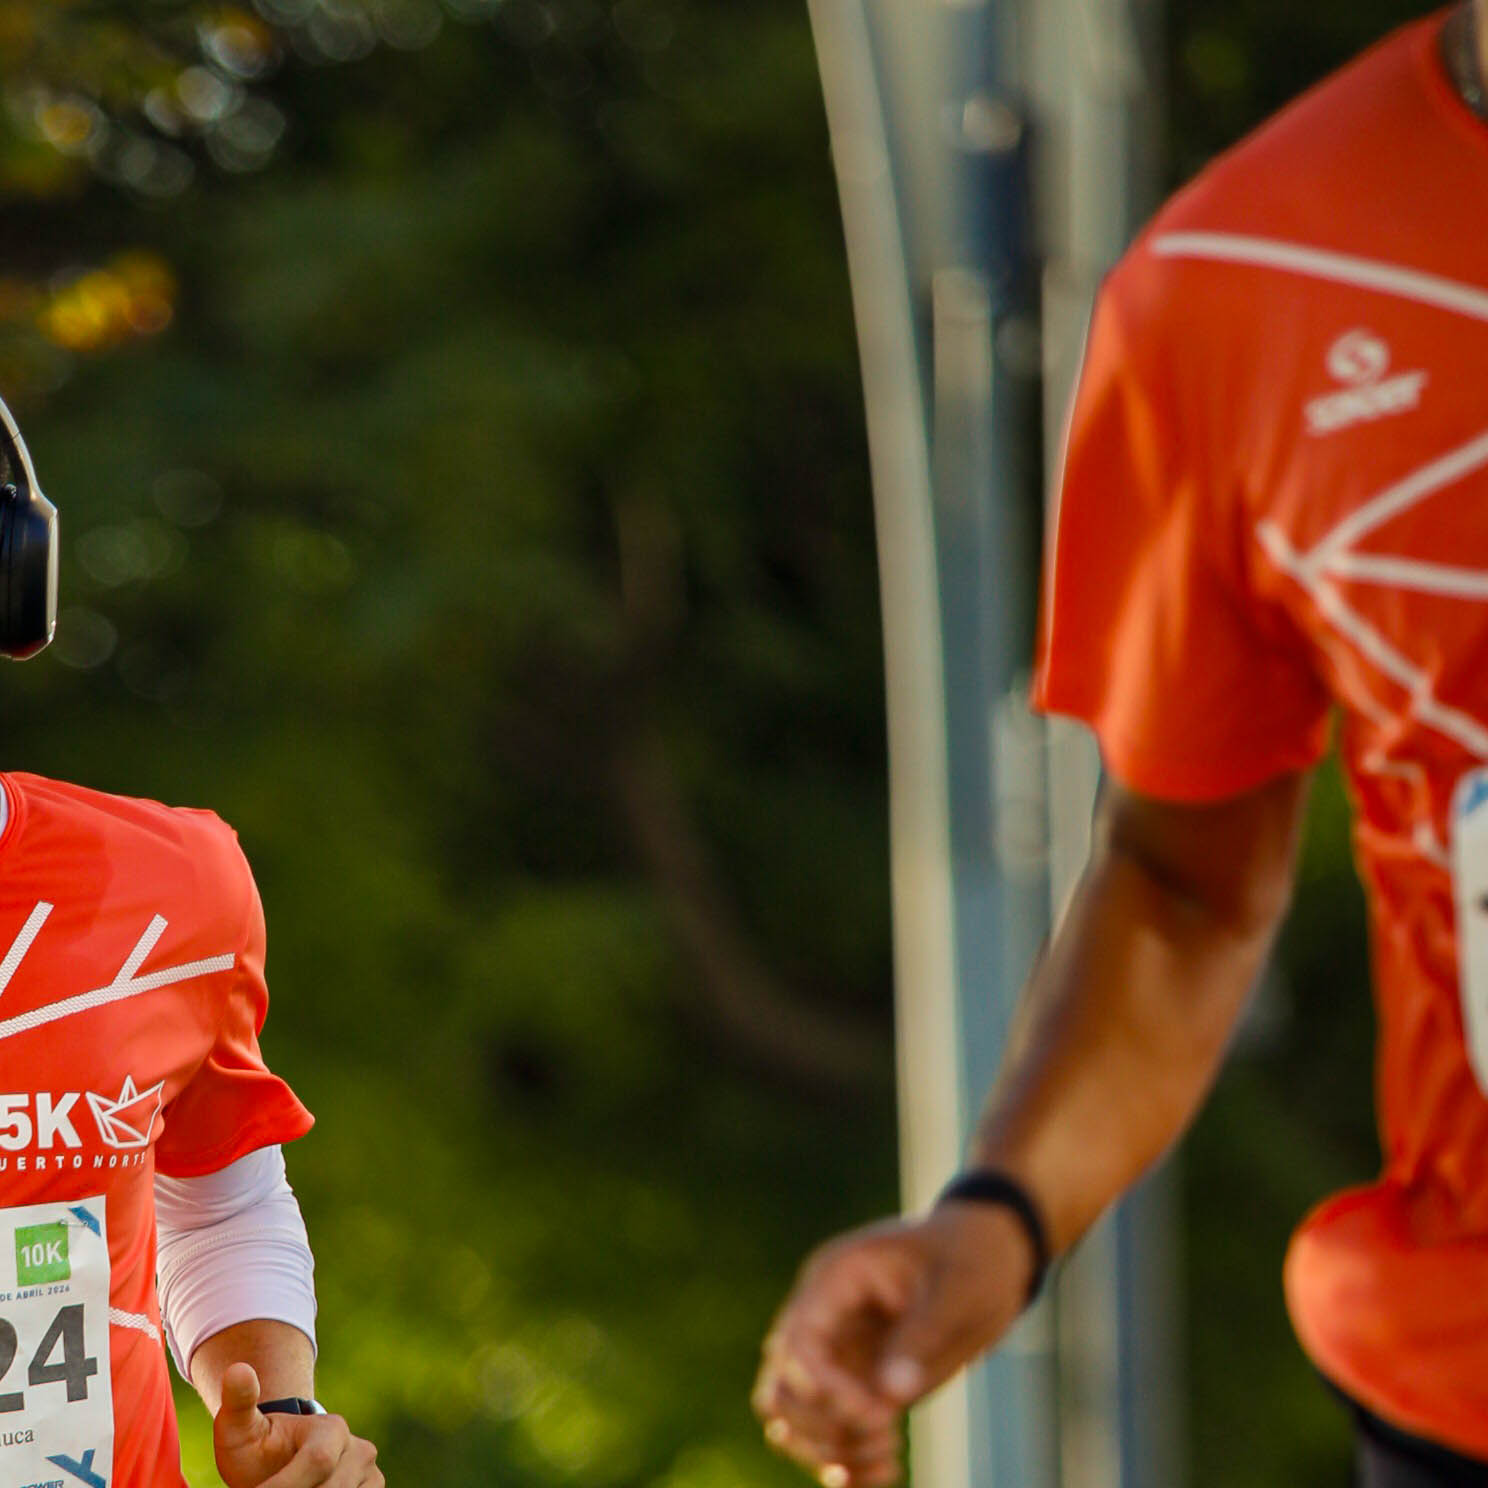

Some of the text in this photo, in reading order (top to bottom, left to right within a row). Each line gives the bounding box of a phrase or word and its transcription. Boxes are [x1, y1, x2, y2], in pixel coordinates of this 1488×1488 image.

[93, 1152, 146, 1169] NORTE
[20, 1239, 65, 1269] 10K
[0, 1293, 12, 1302] DE
[15, 1290, 44, 1300] ABRIL
[47, 1285, 71, 1296] 2026
